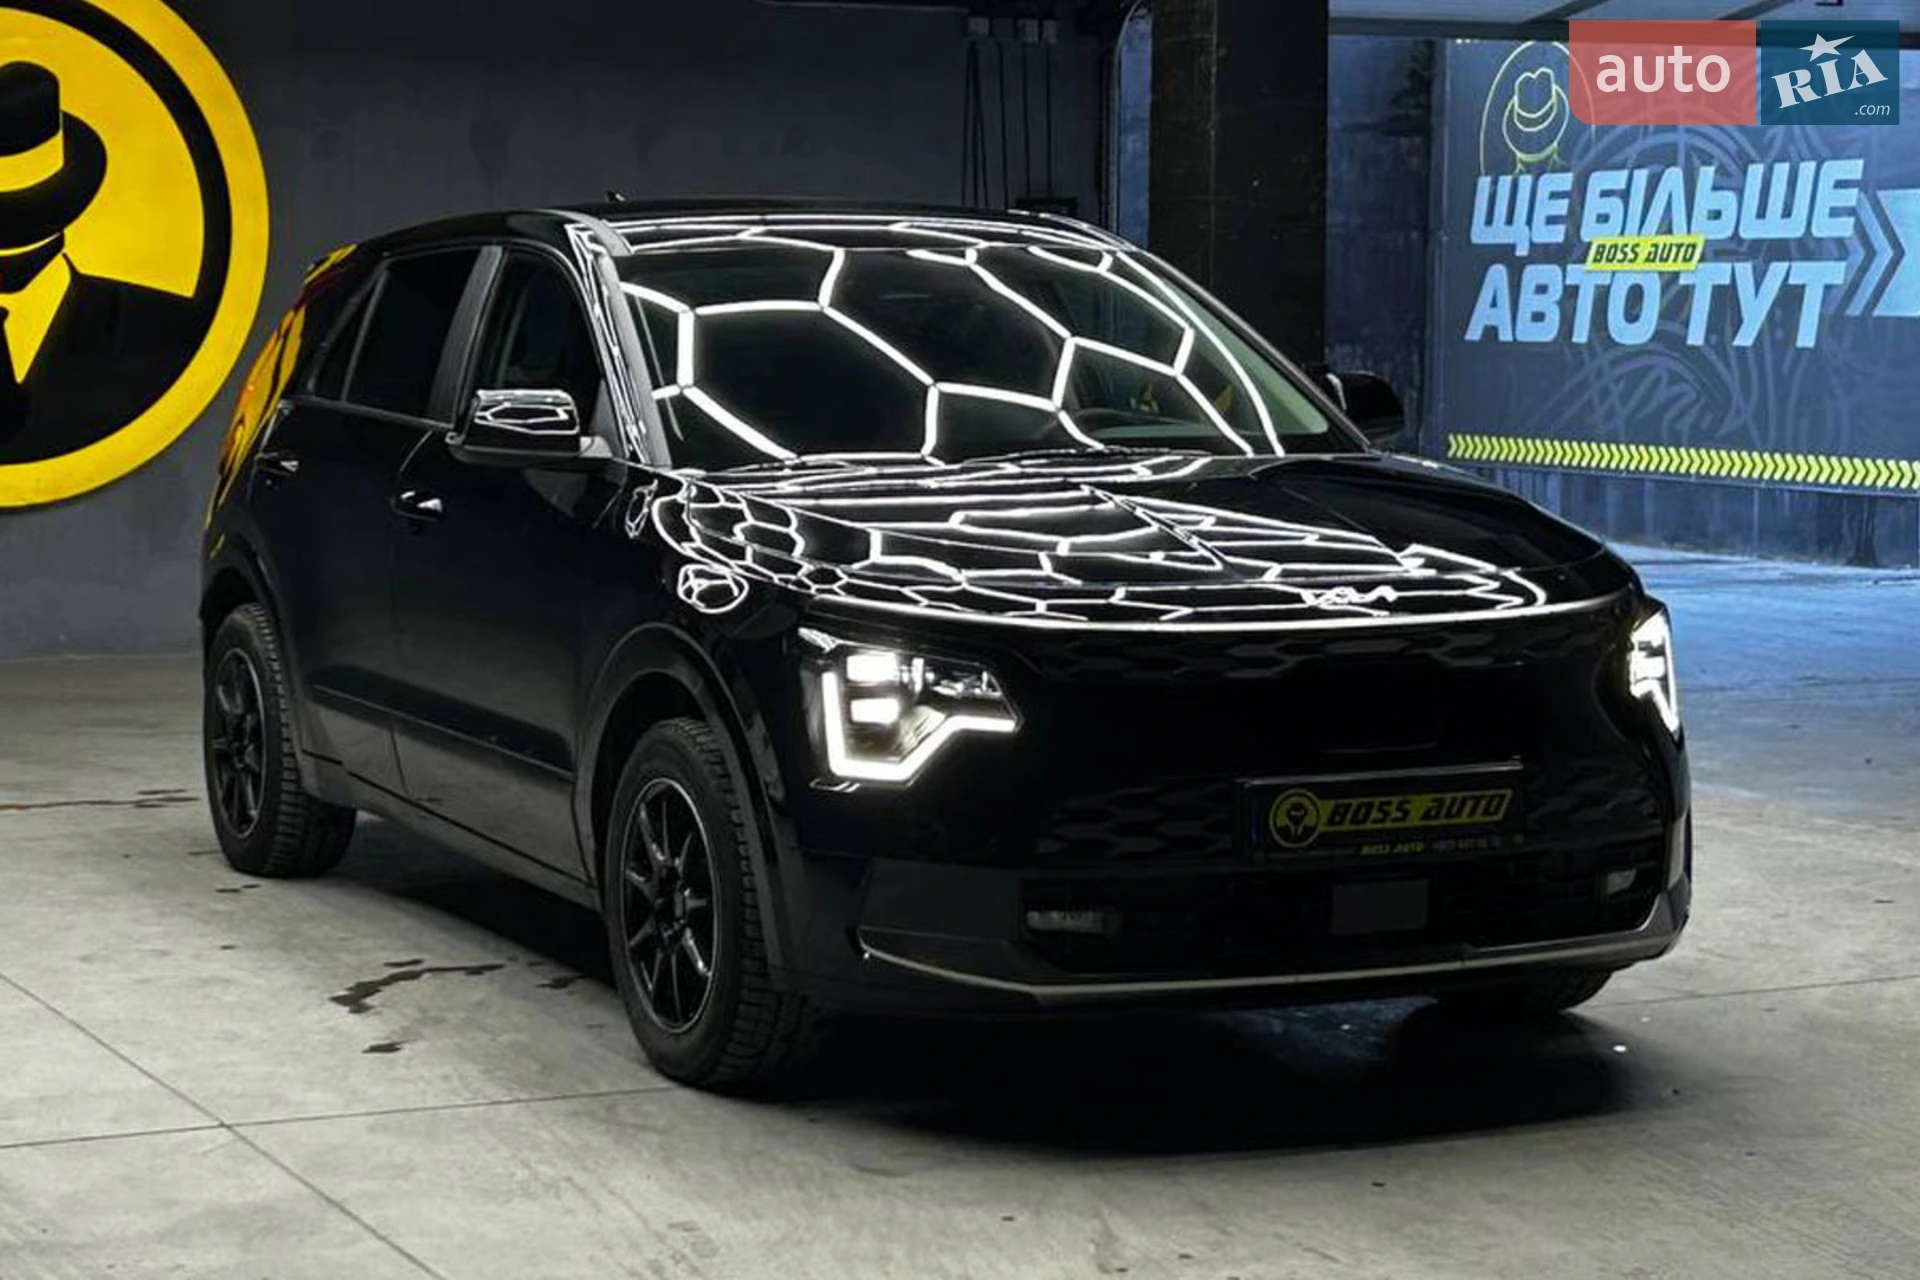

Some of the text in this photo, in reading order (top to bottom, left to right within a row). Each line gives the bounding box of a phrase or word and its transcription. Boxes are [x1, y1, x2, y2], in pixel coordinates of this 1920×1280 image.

[1470, 158, 1864, 256] ЩЕ БІЛЬШЕ
[1592, 242, 1698, 264] BOSS AUTO
[1464, 260, 1847, 349] АВТО ТУТ
[1326, 790, 1508, 827] BOSS AUTO
